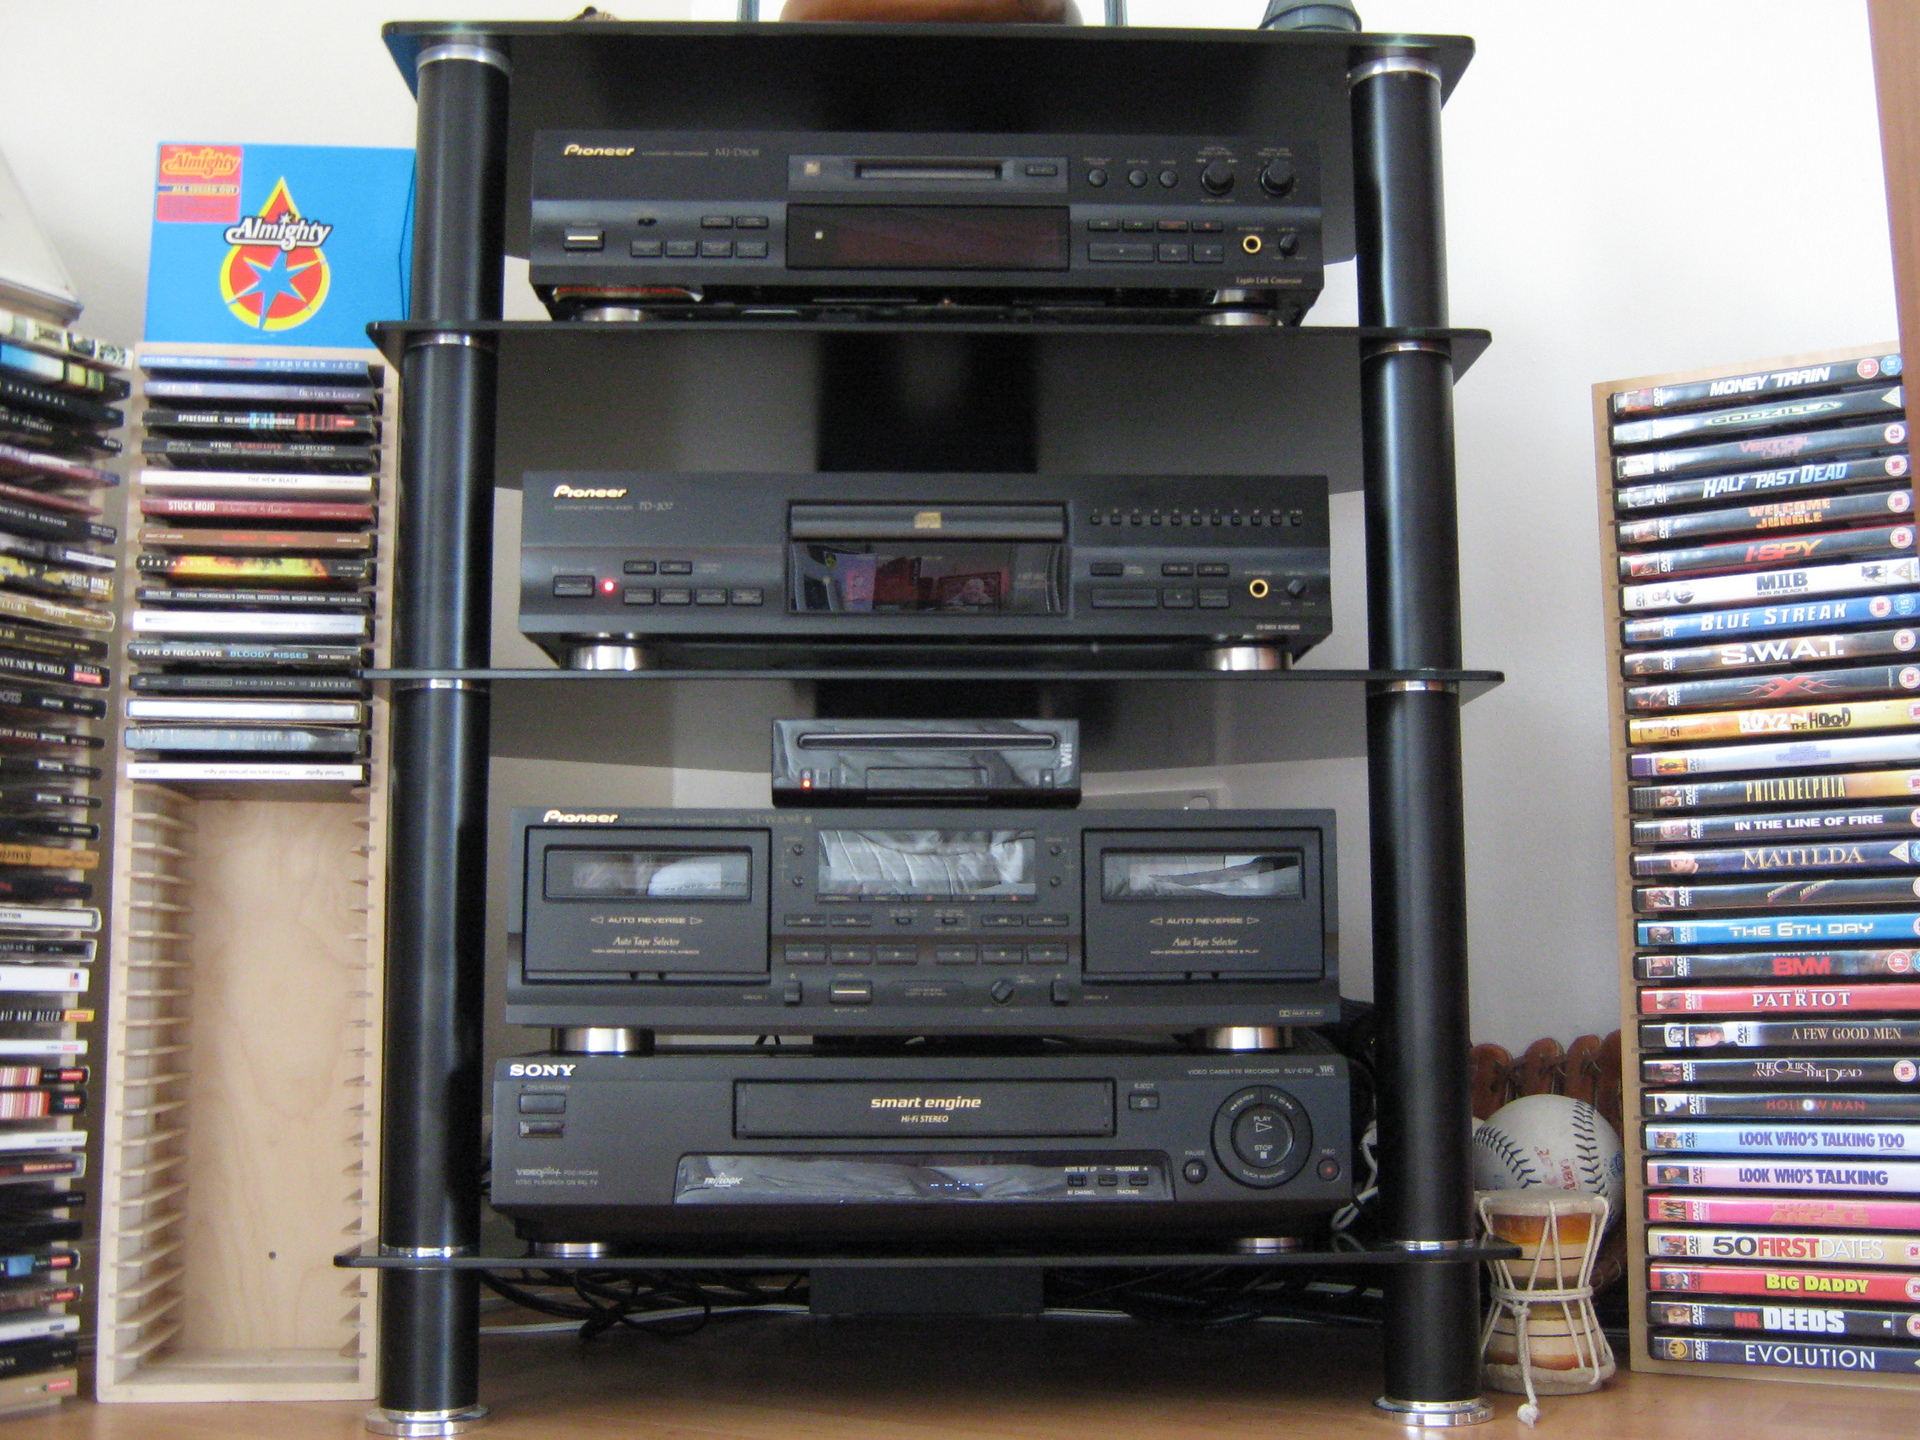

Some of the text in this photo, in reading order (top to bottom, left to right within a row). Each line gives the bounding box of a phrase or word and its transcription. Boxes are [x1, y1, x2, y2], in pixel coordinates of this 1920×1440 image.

[564, 143, 635, 157] Pioneer
[162, 149, 240, 178] Almighty
[226, 213, 332, 250] Almighty
[1709, 367, 1830, 396] MONEY TRAIN
[1711, 403, 1836, 424] GODZILLA
[1889, 428, 1900, 439] 12
[1703, 463, 1848, 498] HALF PAST DEAD
[553, 485, 627, 498] Pioneer
[169, 501, 193, 511] STUCK
[195, 501, 215, 512] MOJO
[1748, 498, 1831, 517] WELCOME
[1756, 512, 1822, 528] JUNGLE
[1745, 539, 1823, 562] I-SPY
[1757, 572, 1808, 591] MIIB
[1700, 603, 1847, 631] BLUE STREAK
[1721, 636, 1844, 665] S.W.A.T.
[17, 660, 66, 675] NEW WORLD
[1738, 711, 1791, 733] BOYZ
[1809, 707, 1851, 728] HOOD
[1746, 776, 1846, 802] PHILADELPHIA
[543, 810, 618, 824] Pioneer
[1734, 814, 1883, 831] IN THE LINE OF FIRE
[1742, 847, 1865, 869] MATILDA
[1729, 922, 1874, 937] THE 6TH DAY
[613, 936, 680, 947] Auto Tape Selector
[1173, 937, 1239, 947] Auto Tape Selector
[1773, 957, 1831, 976] 8MM
[1752, 991, 1850, 1007] PATRIOT
[1792, 1027, 1901, 1040] A FEW GOOD MEN
[509, 1063, 576, 1077] SONY
[1320, 1065, 1334, 1073] VHS
[1755, 1059, 1816, 1073] THE QUICK
[1825, 1068, 1862, 1082] DEAD
[871, 1096, 981, 1110] smart engine
[1767, 1099, 1866, 1111] HOLLOW MAN
[1739, 1132, 1904, 1148] LOOK WHO'S TALKING TOO
[1739, 1168, 1888, 1185] LOOK WHO'S TALKING
[1713, 1237, 1884, 1259] 50 FIRST DATES
[1766, 1274, 1869, 1293] BIG DADDY
[1734, 1307, 1845, 1333] MR. DEEDS
[1745, 1344, 1876, 1369] EVOLUTION
